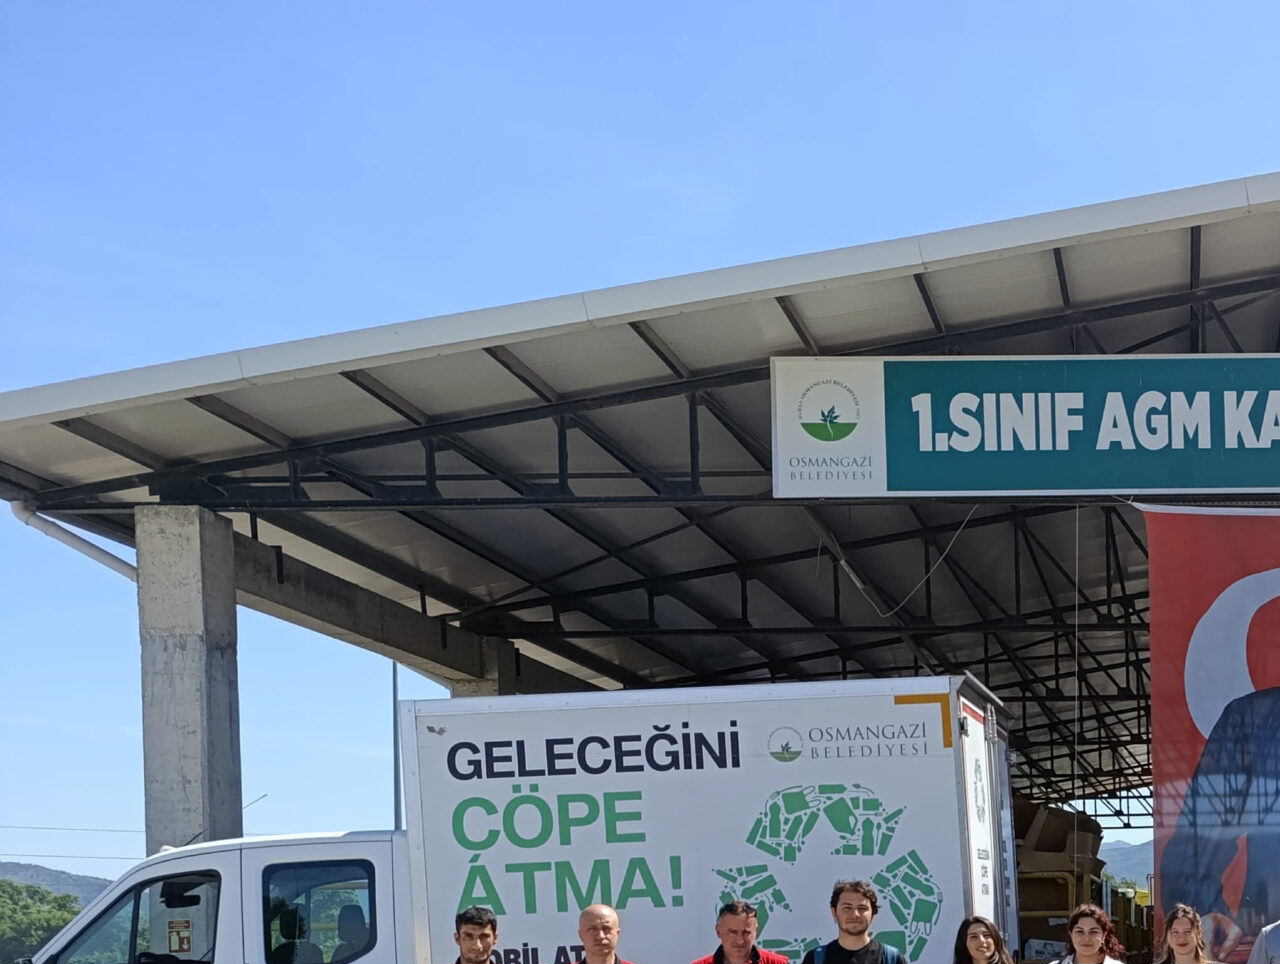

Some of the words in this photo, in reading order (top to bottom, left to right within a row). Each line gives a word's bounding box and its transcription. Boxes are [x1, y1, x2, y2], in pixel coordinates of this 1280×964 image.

[910, 391, 1084, 452] 1.SINIF
[1096, 391, 1212, 451] AGM
[789, 455, 872, 468] OSMANGAZİ
[790, 470, 872, 480] BELEDİYESİ
[808, 721, 927, 743] OSMANGAZİ
[447, 720, 740, 781] GELECEĞİNİ
[811, 741, 928, 760] BELEDİYESİ
